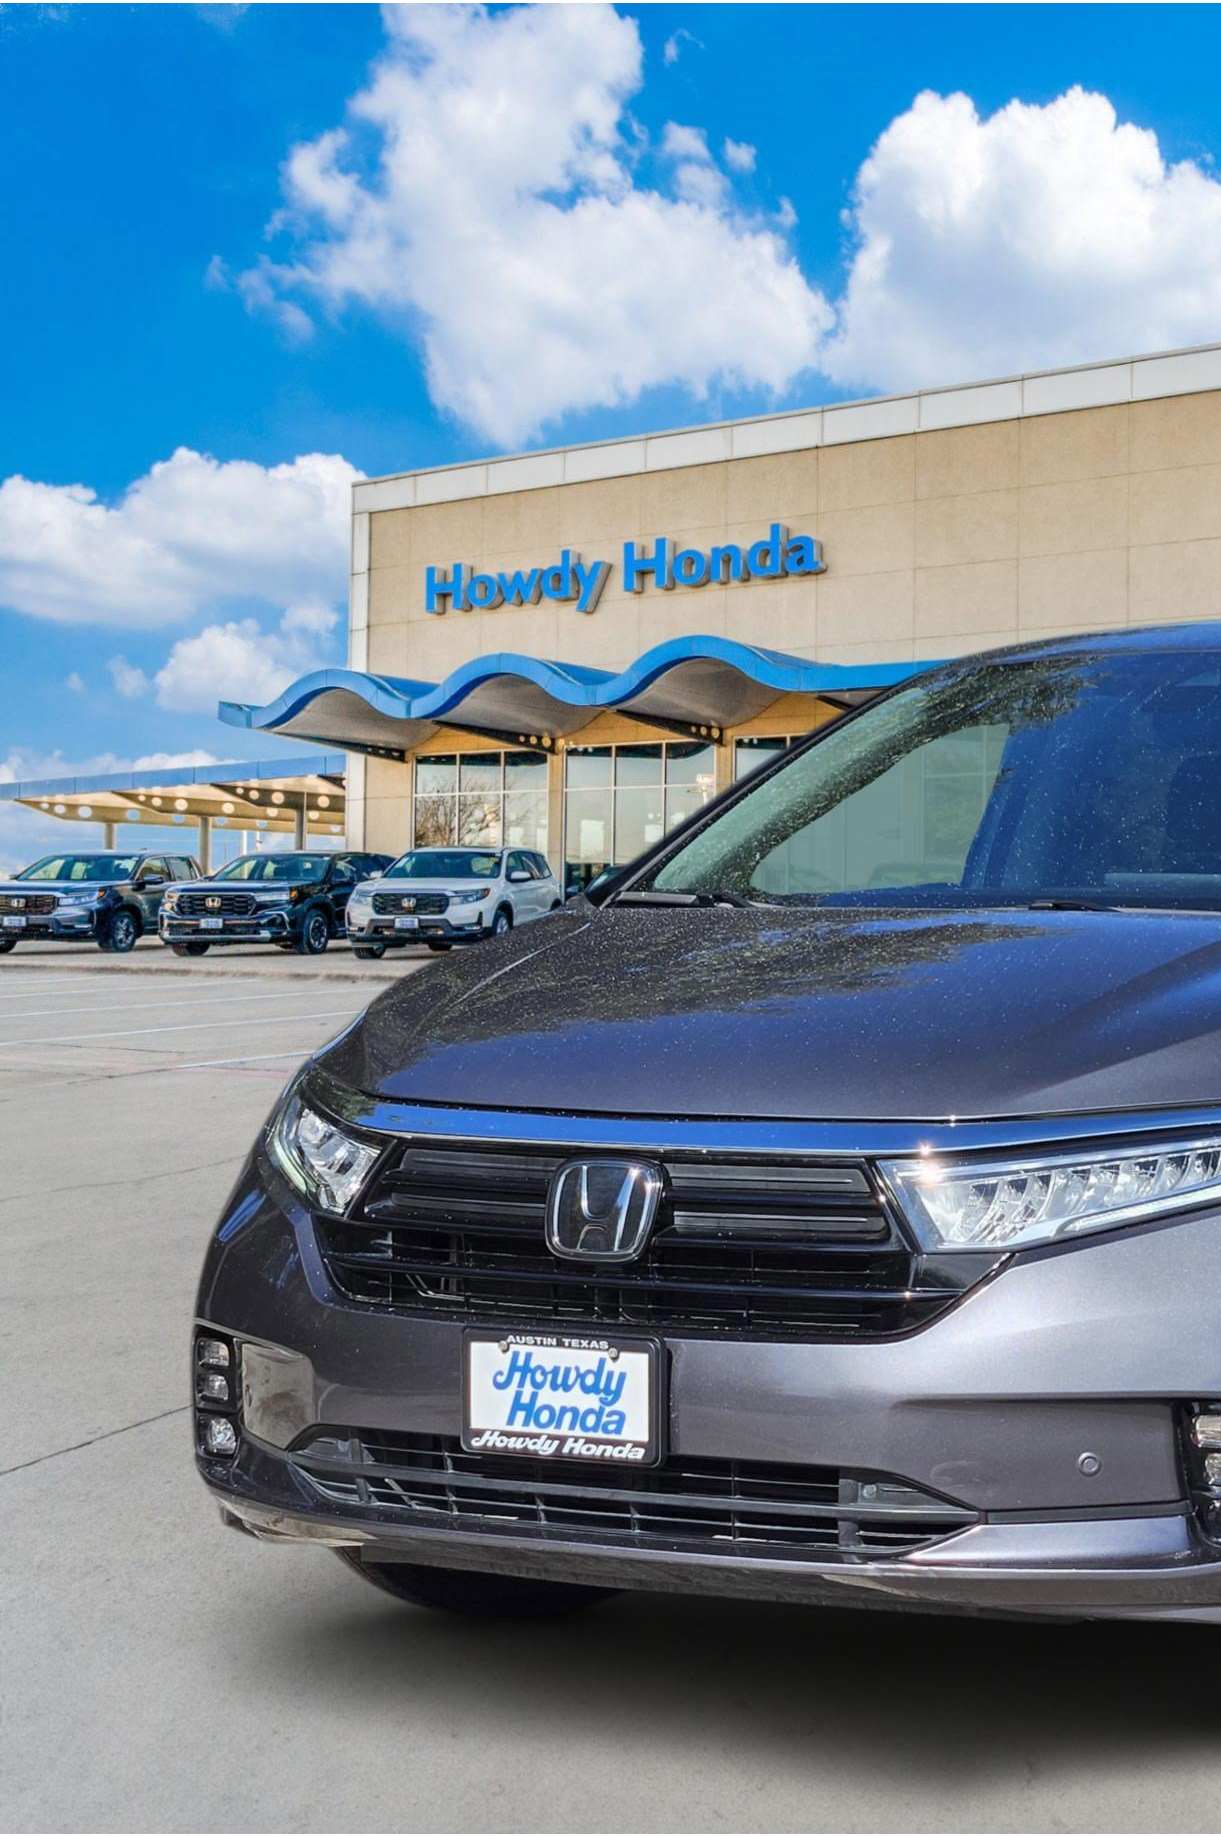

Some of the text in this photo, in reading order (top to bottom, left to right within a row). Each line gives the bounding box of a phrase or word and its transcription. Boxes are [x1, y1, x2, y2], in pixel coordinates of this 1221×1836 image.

[425, 523, 825, 614] Howdy Honda
[506, 1334, 609, 1350] AUSTIN TEXAS
[492, 1350, 627, 1407] Howdy
[506, 1390, 627, 1436] Honda
[471, 1430, 645, 1460] Howdy Honda
